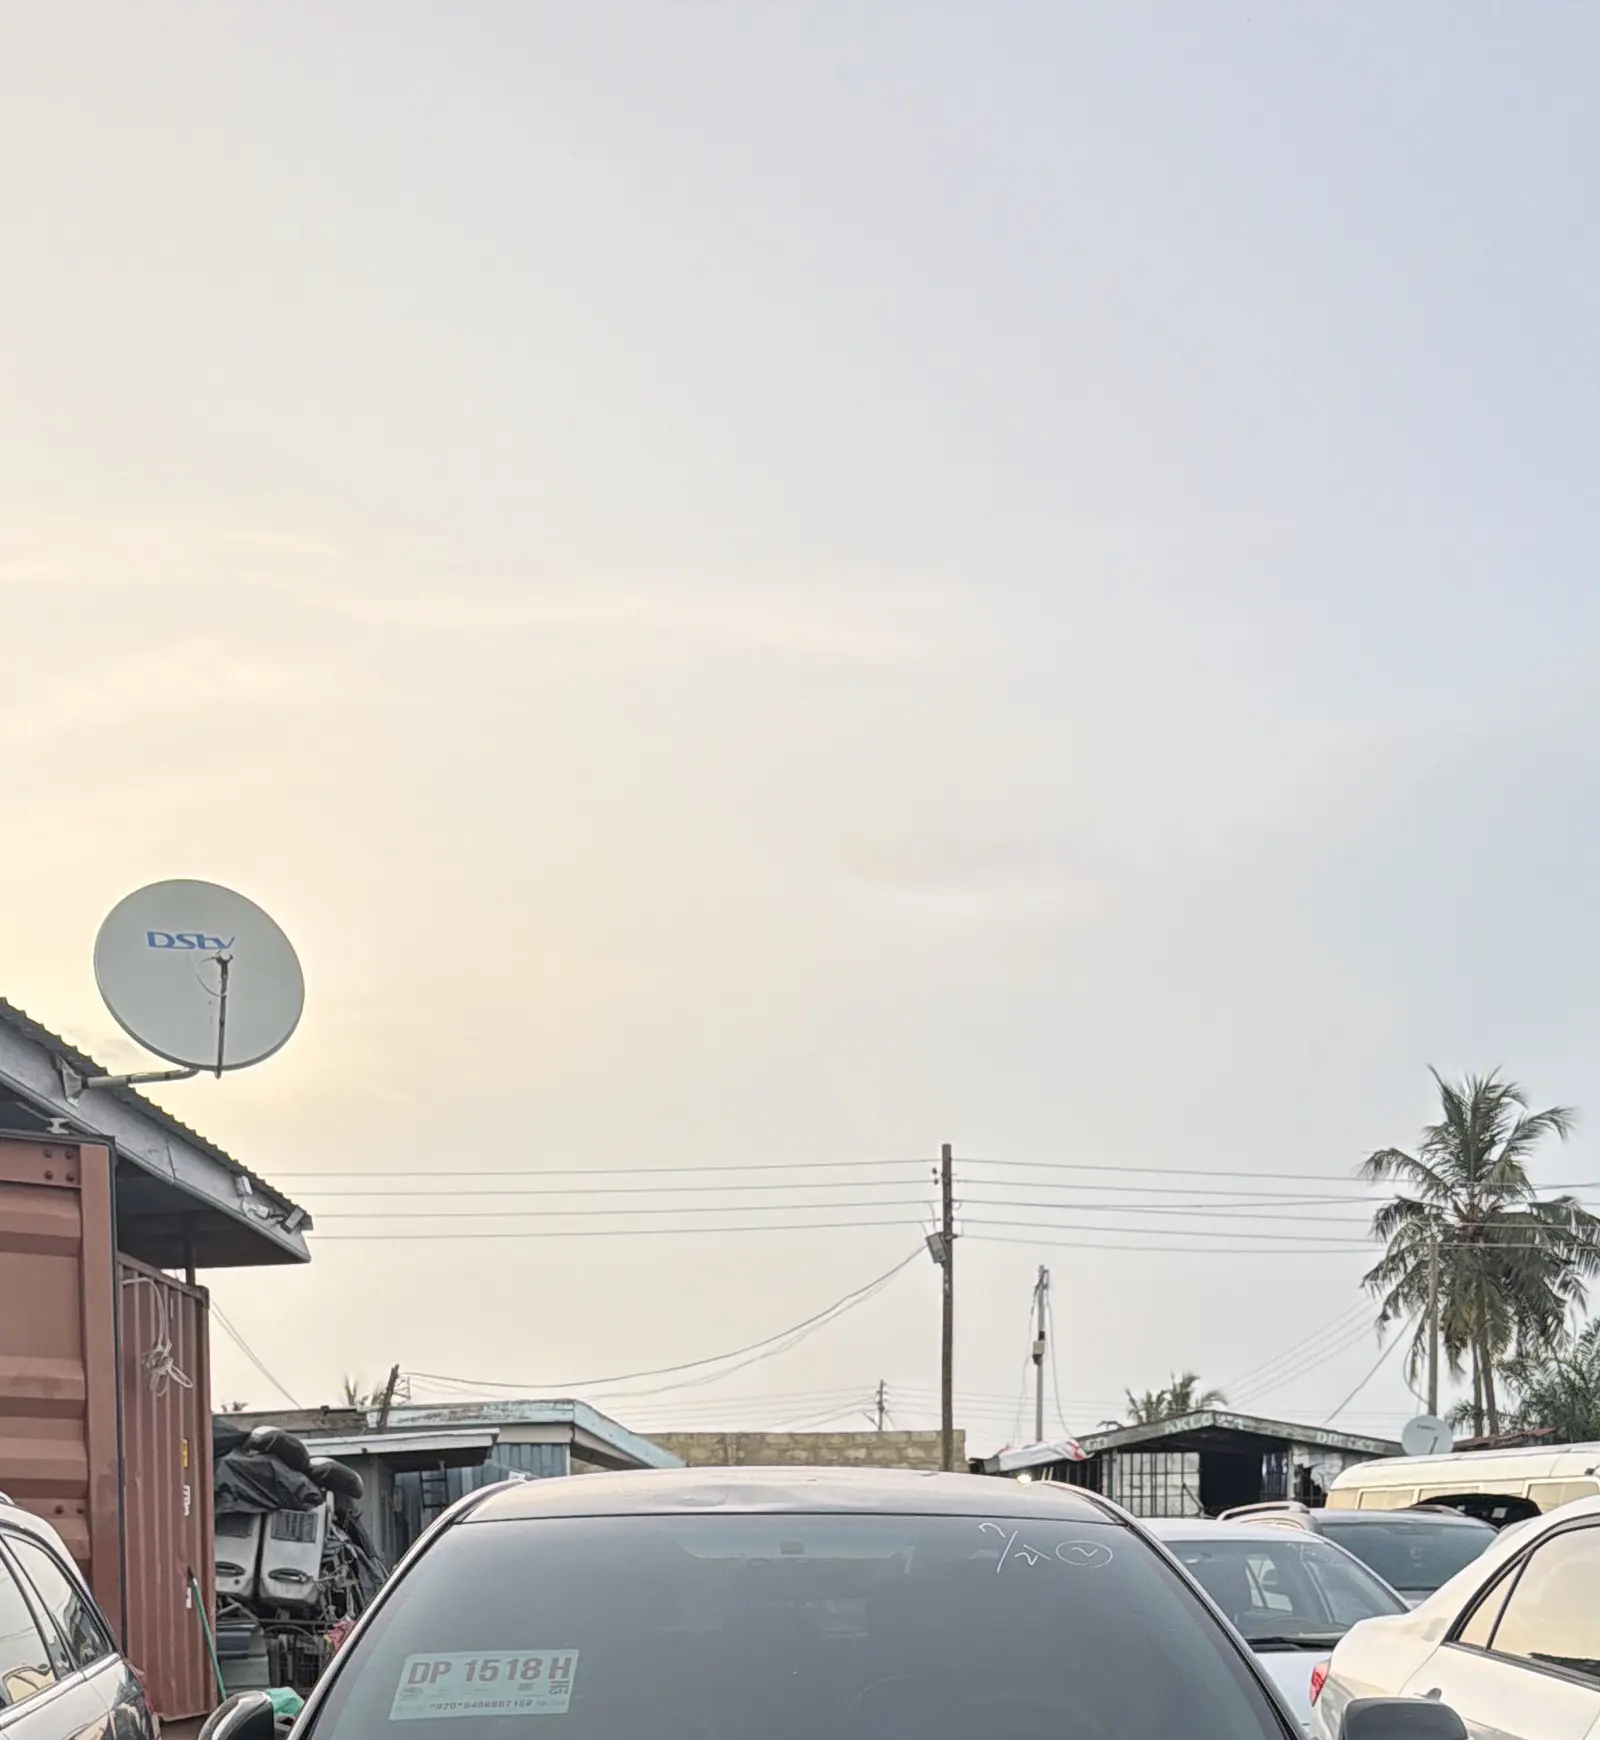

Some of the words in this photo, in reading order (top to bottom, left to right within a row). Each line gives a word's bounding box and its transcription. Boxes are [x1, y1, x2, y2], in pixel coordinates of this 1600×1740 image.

[407, 1660, 452, 1685] DP
[464, 1657, 543, 1683] 1518
[548, 1656, 573, 1680] H
